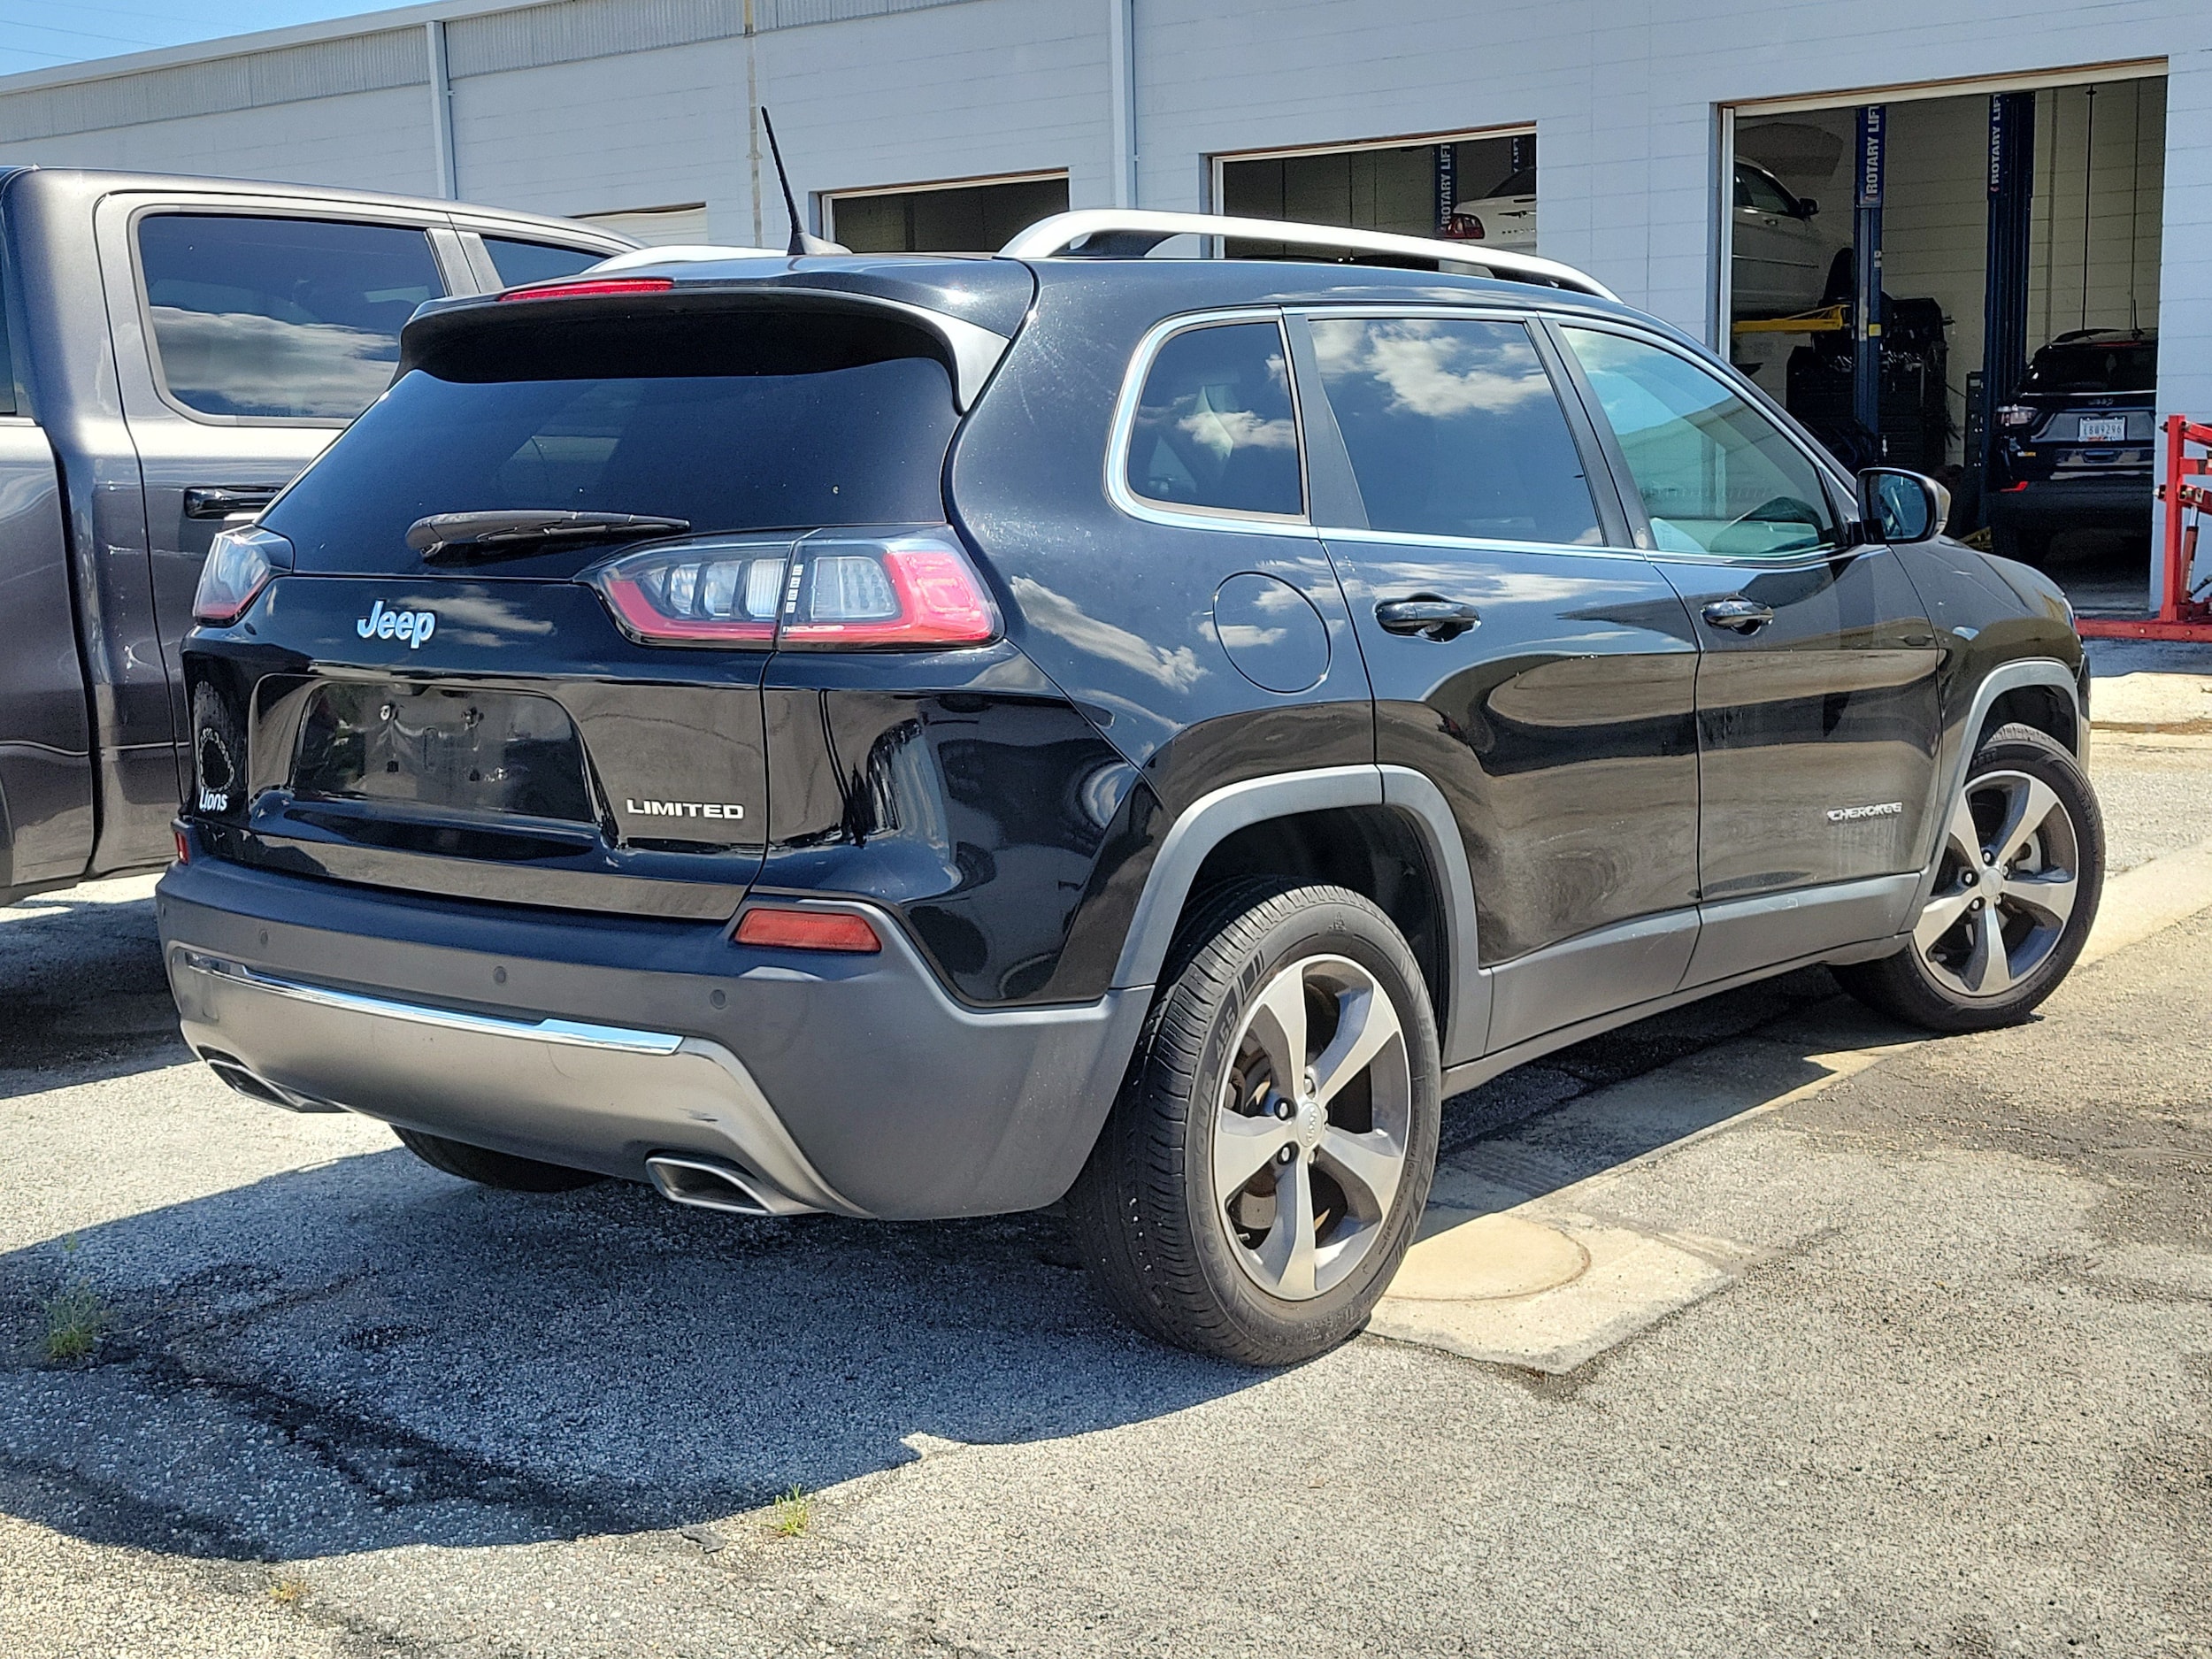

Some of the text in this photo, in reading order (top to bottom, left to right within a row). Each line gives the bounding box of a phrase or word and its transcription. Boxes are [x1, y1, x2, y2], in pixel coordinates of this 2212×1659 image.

[1866, 136, 1878, 194] ROTARY
[1992, 126, 2001, 184] ROTARY
[1440, 173, 1451, 224] ROTARY
[357, 601, 435, 649] Jeep
[626, 799, 744, 819] LIMITED
[1826, 802, 1902, 821] CHEROKEE
[1215, 1006, 1236, 1061] 455
